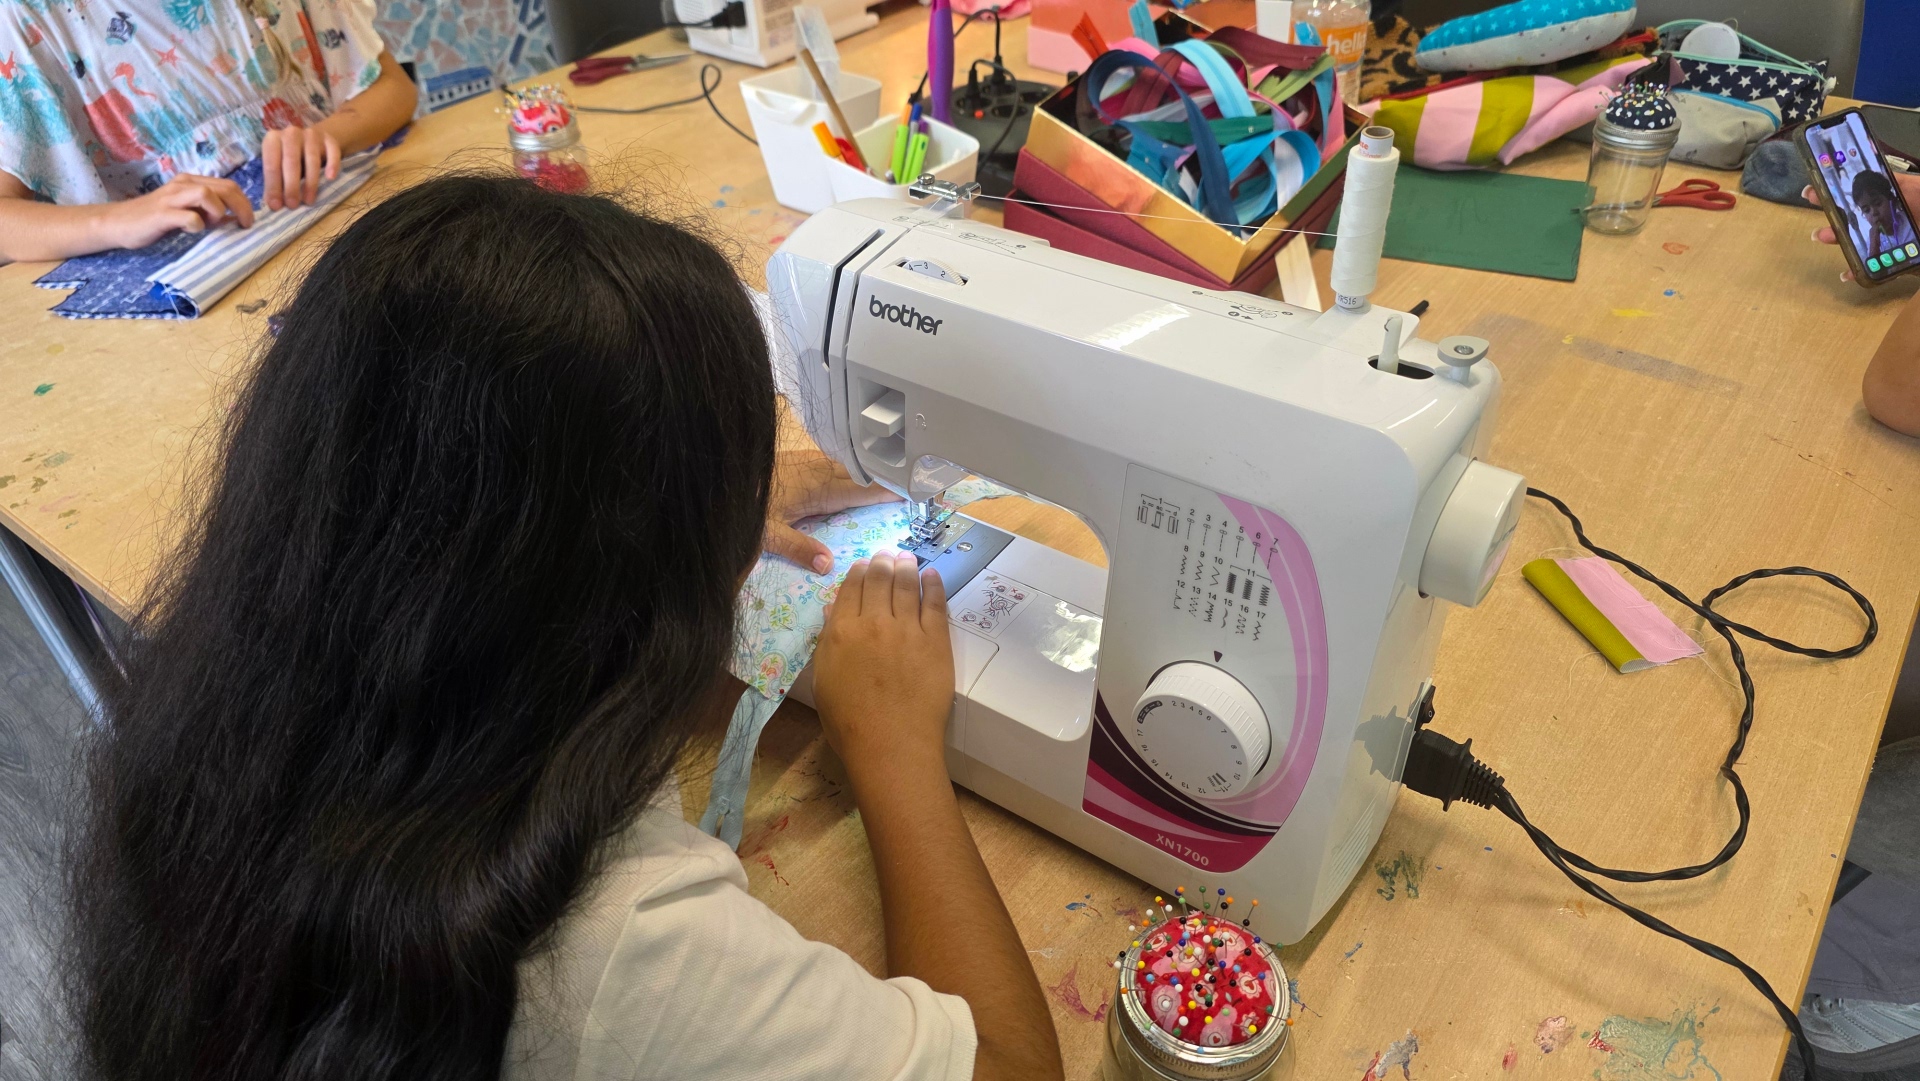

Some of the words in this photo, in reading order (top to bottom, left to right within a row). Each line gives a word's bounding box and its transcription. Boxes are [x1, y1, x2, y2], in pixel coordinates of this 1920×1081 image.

[869, 294, 942, 336] brother
[1214, 556, 1223, 565] 10
[1247, 569, 1255, 577] 11
[1177, 580, 1185, 588] 12
[1192, 586, 1201, 594] 13
[1208, 592, 1217, 600] 14
[1224, 598, 1232, 606] 15
[1240, 605, 1249, 613] 16
[1257, 611, 1266, 619] 17
[1156, 834, 1210, 866] XN1700
